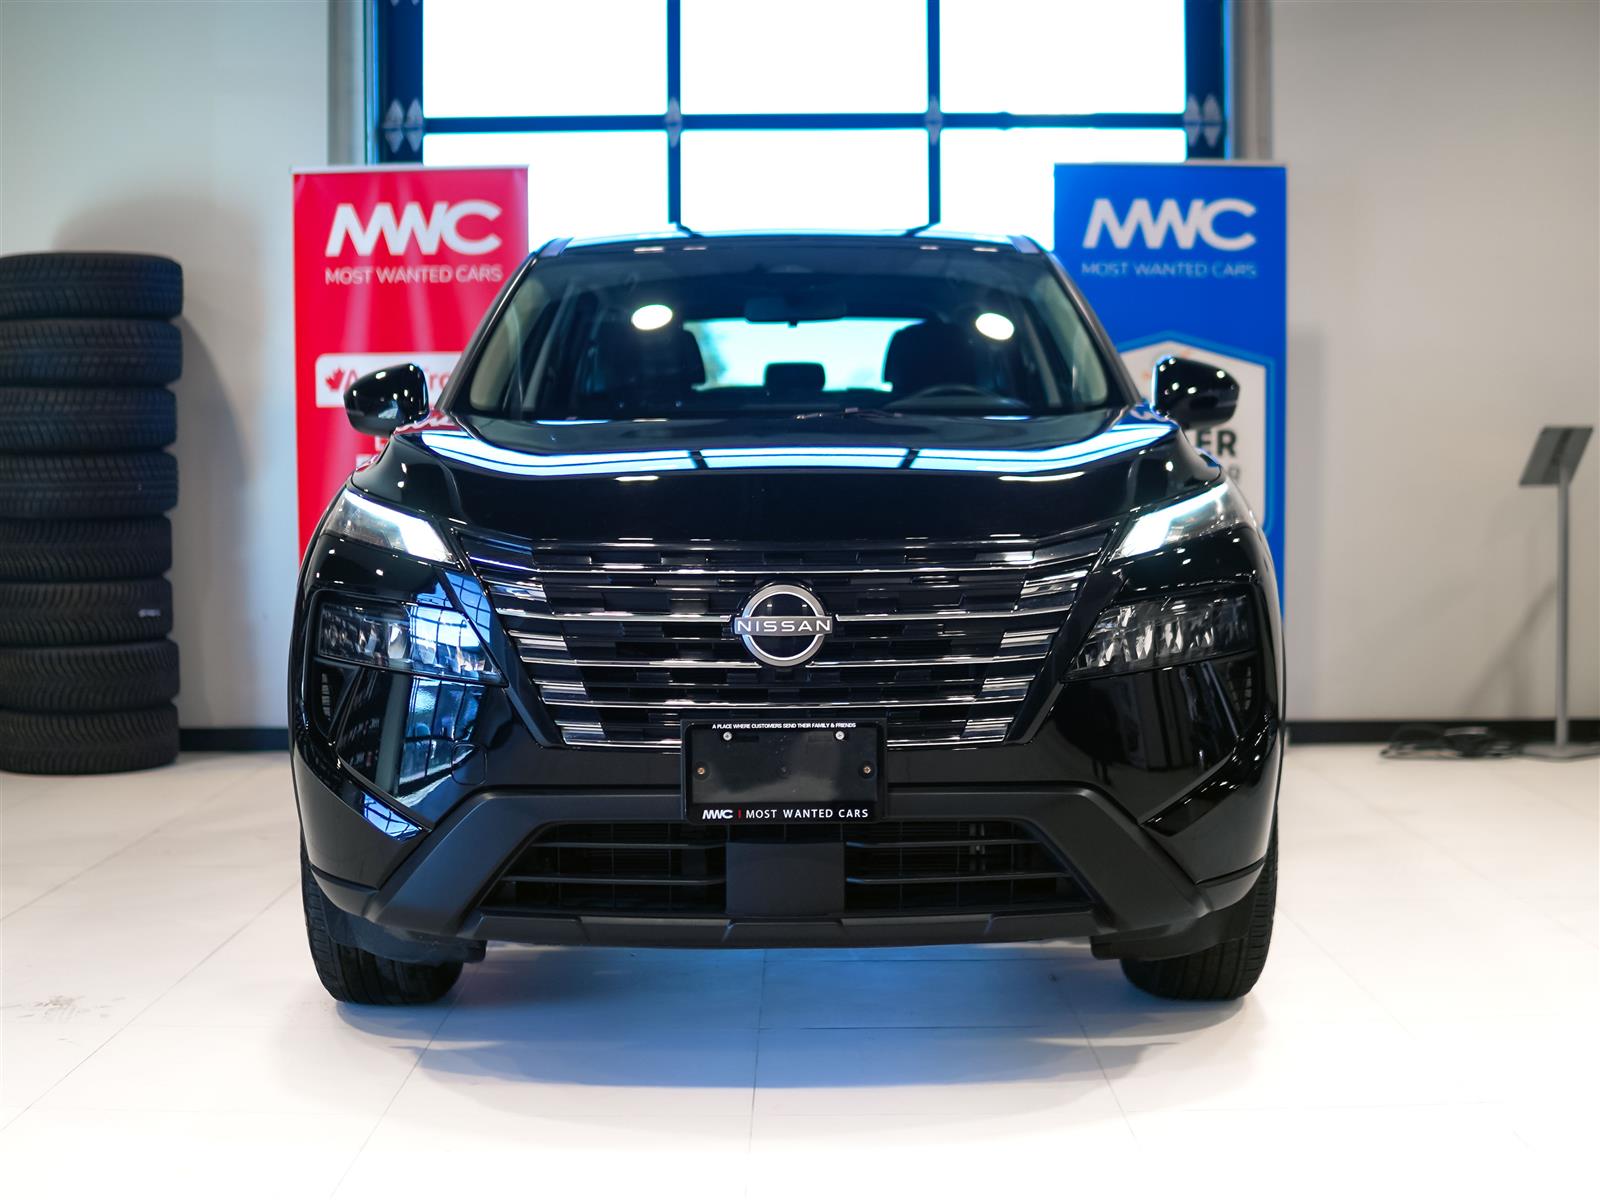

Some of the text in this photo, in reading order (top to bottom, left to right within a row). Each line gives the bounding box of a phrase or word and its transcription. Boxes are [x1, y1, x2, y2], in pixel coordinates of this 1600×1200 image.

[325, 200, 502, 257] MWC
[1082, 198, 1256, 251] MWC
[325, 264, 503, 285] MOST WANTED CARS
[1081, 262, 1257, 278] MOST WANTED CARS
[737, 620, 830, 632] NISSAN
[702, 809, 869, 820] MWC MOST WANTED CARS
